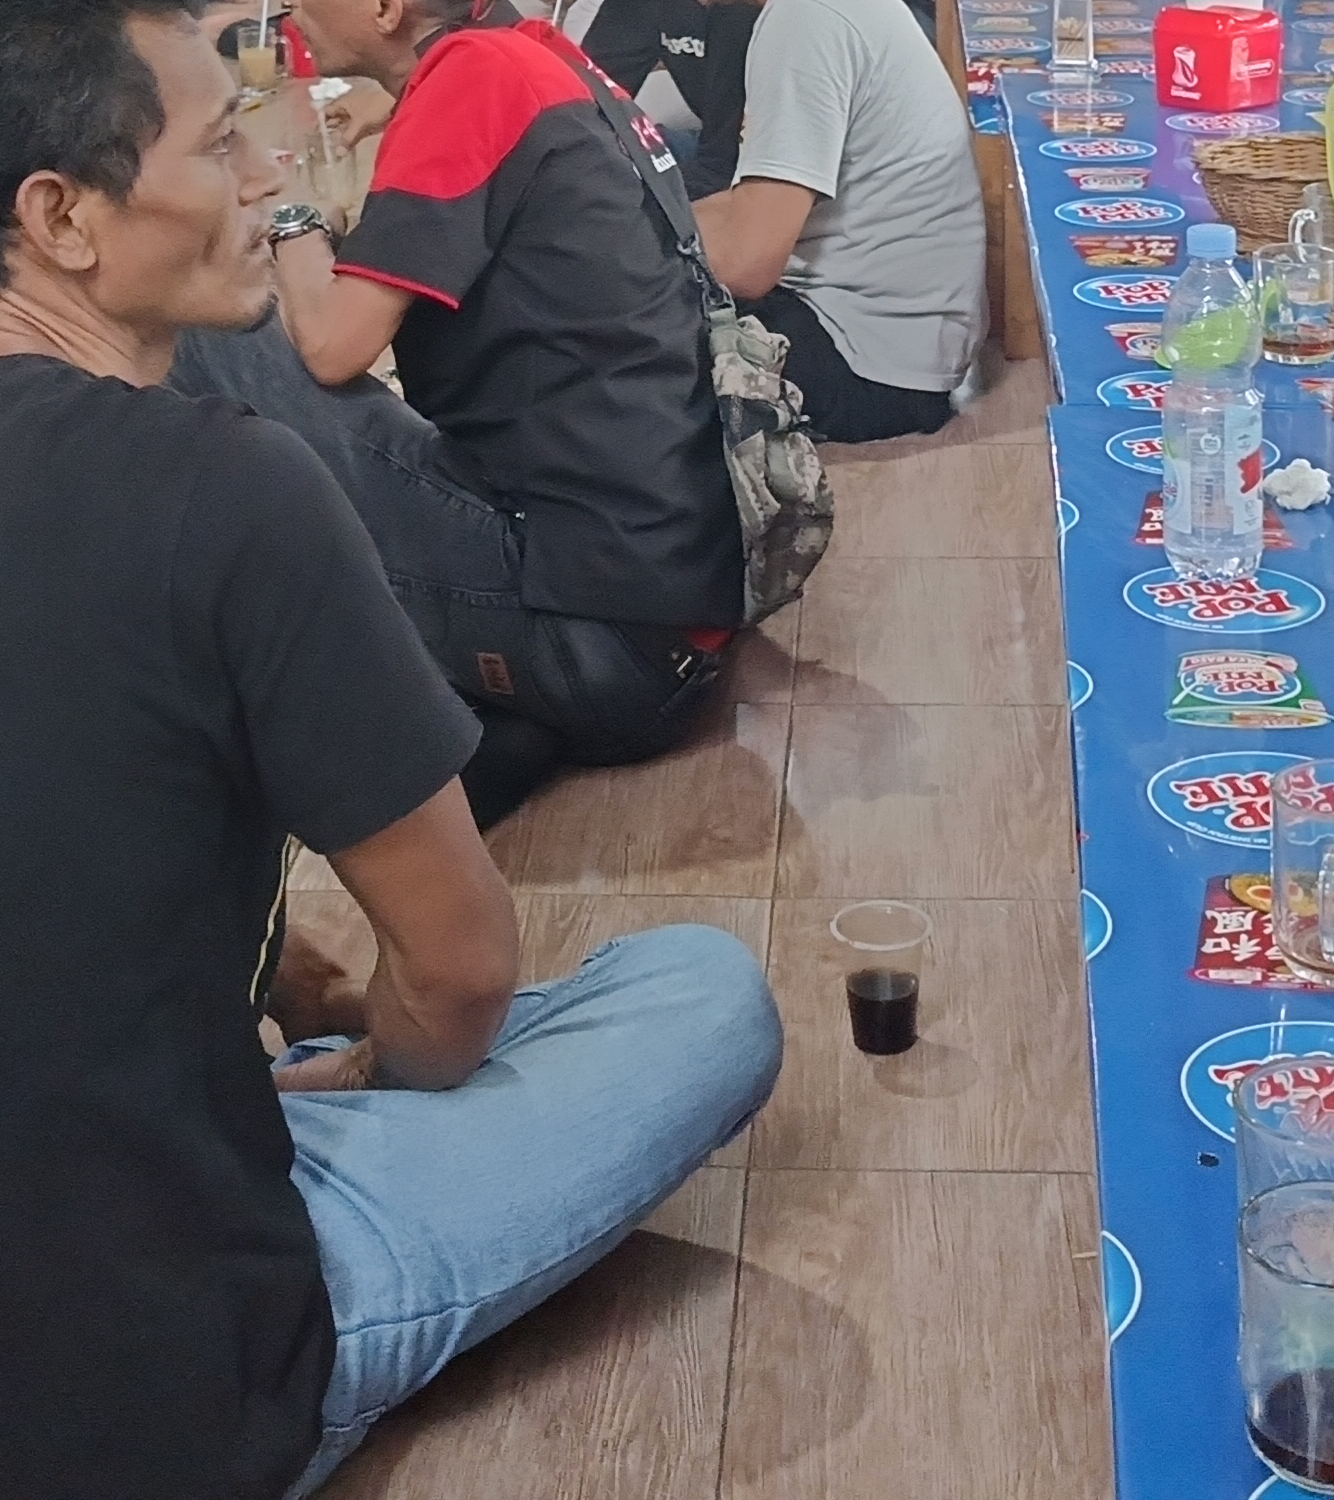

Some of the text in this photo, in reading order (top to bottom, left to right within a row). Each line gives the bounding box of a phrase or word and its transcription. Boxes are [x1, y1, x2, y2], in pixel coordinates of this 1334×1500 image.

[1060, 138, 1123, 153] POP
[1078, 146, 1147, 159] MIE
[1076, 200, 1143, 218] POP
[1095, 209, 1173, 224] MIE
[1092, 280, 1170, 299] POP
[1142, 576, 1262, 607] MIE
[1189, 590, 1305, 621] POP
[1201, 670, 1265, 682] MIE
[1214, 680, 1285, 696] POP
